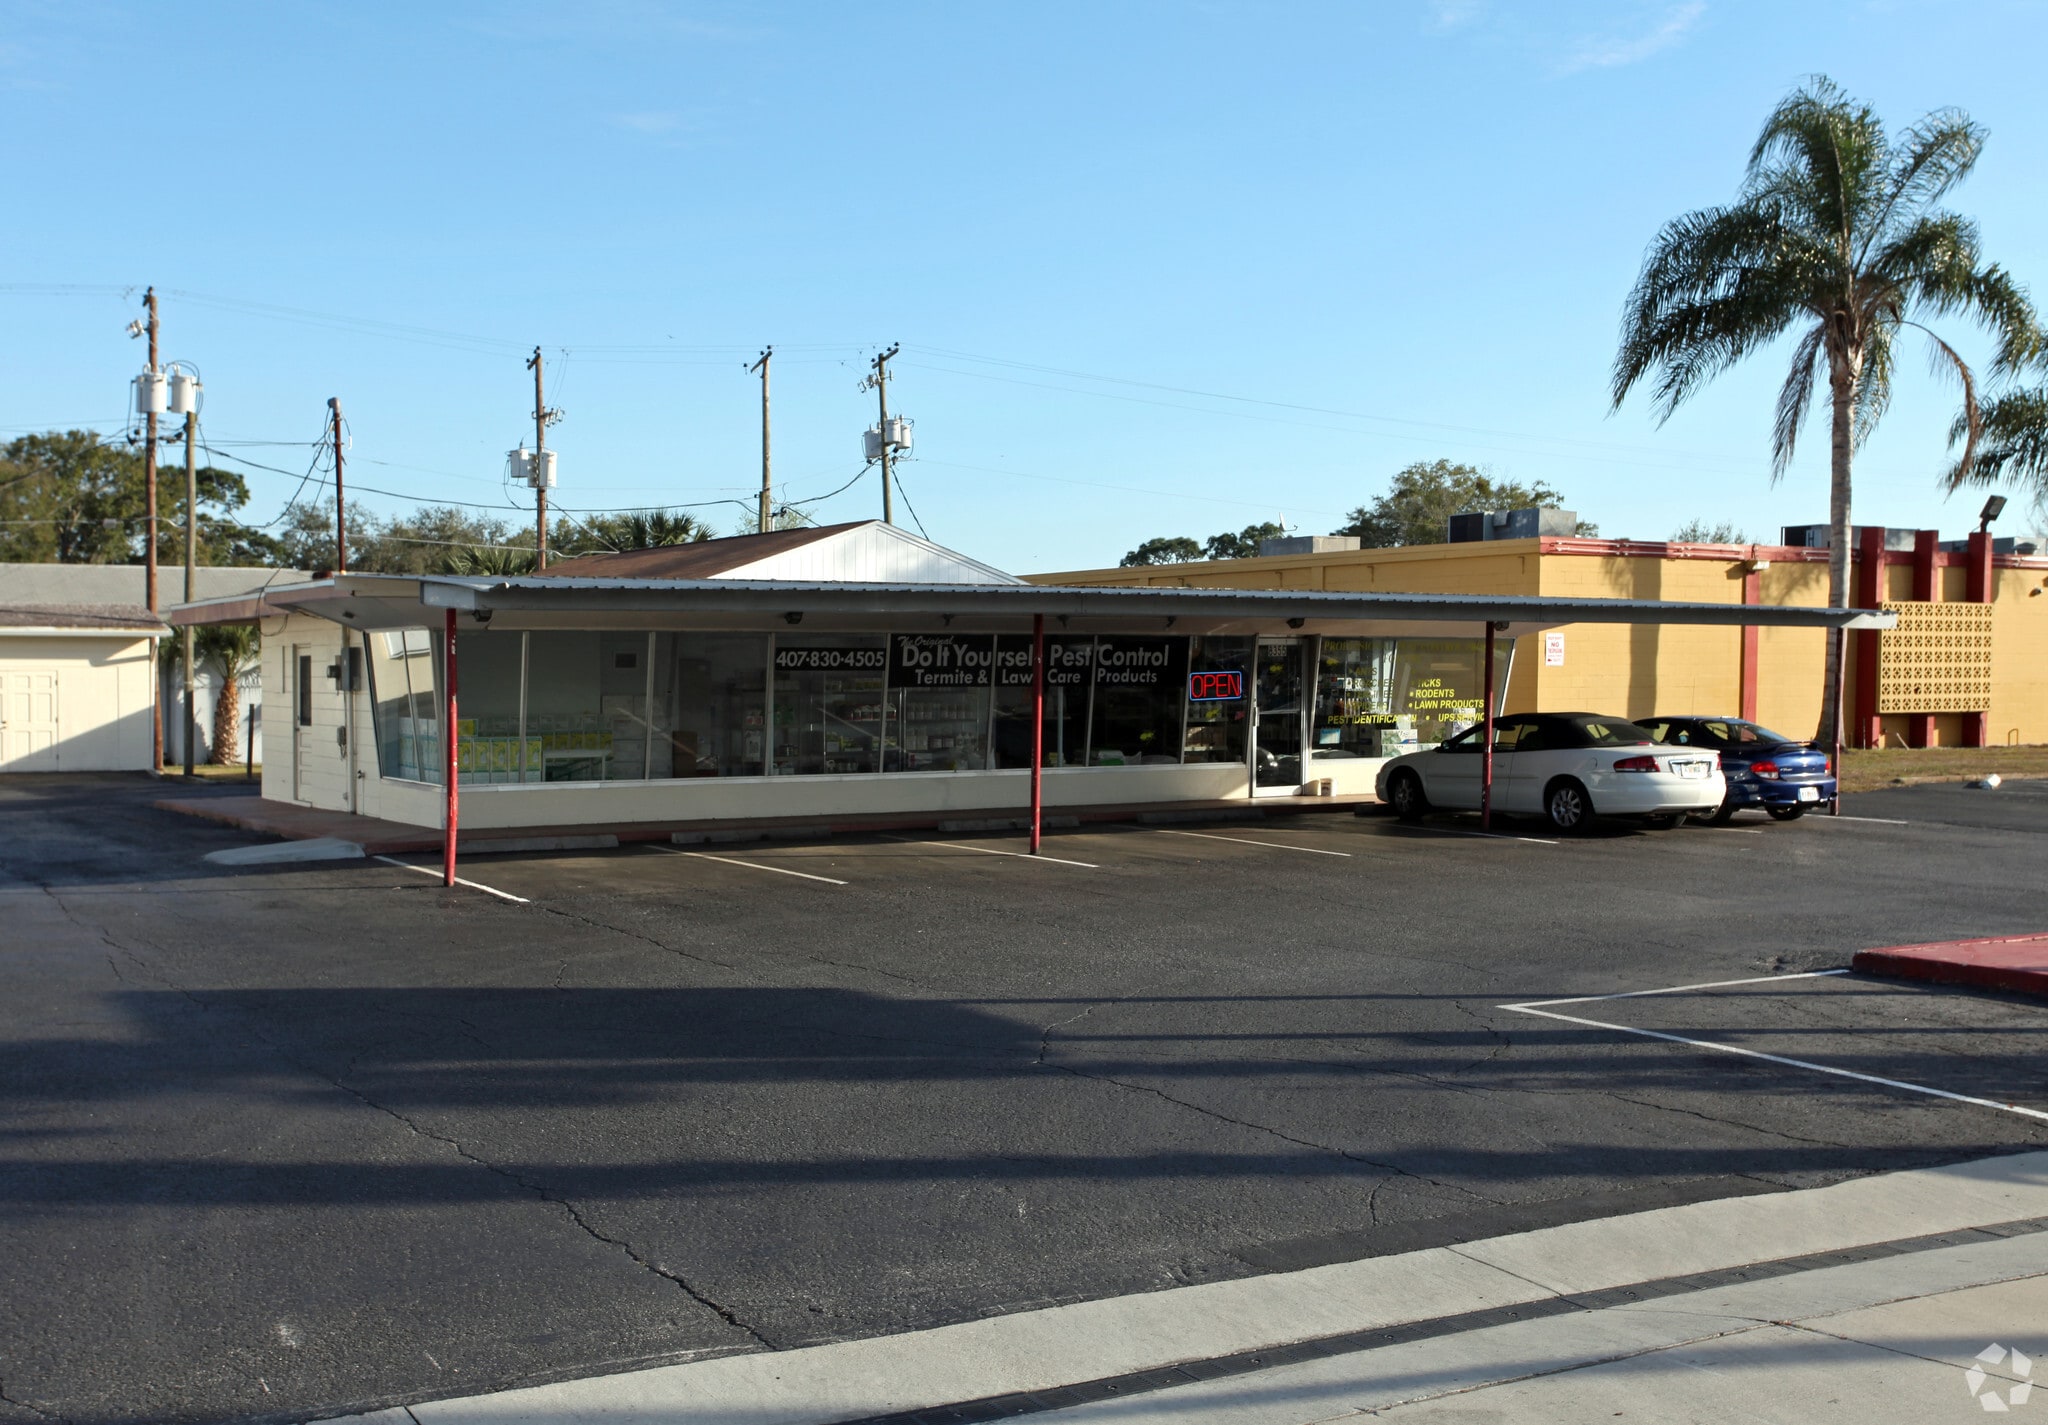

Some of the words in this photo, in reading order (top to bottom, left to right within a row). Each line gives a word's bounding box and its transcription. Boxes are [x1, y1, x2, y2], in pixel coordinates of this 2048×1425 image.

[914, 635, 954, 648] Original
[902, 644, 933, 667] Do
[936, 644, 951, 667] It
[952, 643, 1034, 667] Yoursel
[1050, 644, 1092, 667] Pest
[1098, 644, 1169, 667] Control
[915, 668, 973, 685] Termite
[977, 671, 988, 685] &
[1002, 668, 1033, 684] Law
[1047, 668, 1081, 684] Care
[1097, 668, 1157, 684] Products
[1191, 673, 1241, 698] OPEN
[1416, 689, 1455, 698] RODENTS
[1414, 700, 1438, 709] LAWN
[1440, 699, 1485, 709] PRODUCTS
[1327, 715, 1350, 725] PEST
[1438, 713, 1455, 722] UPS
[1457, 712, 1485, 722] SERVIC
